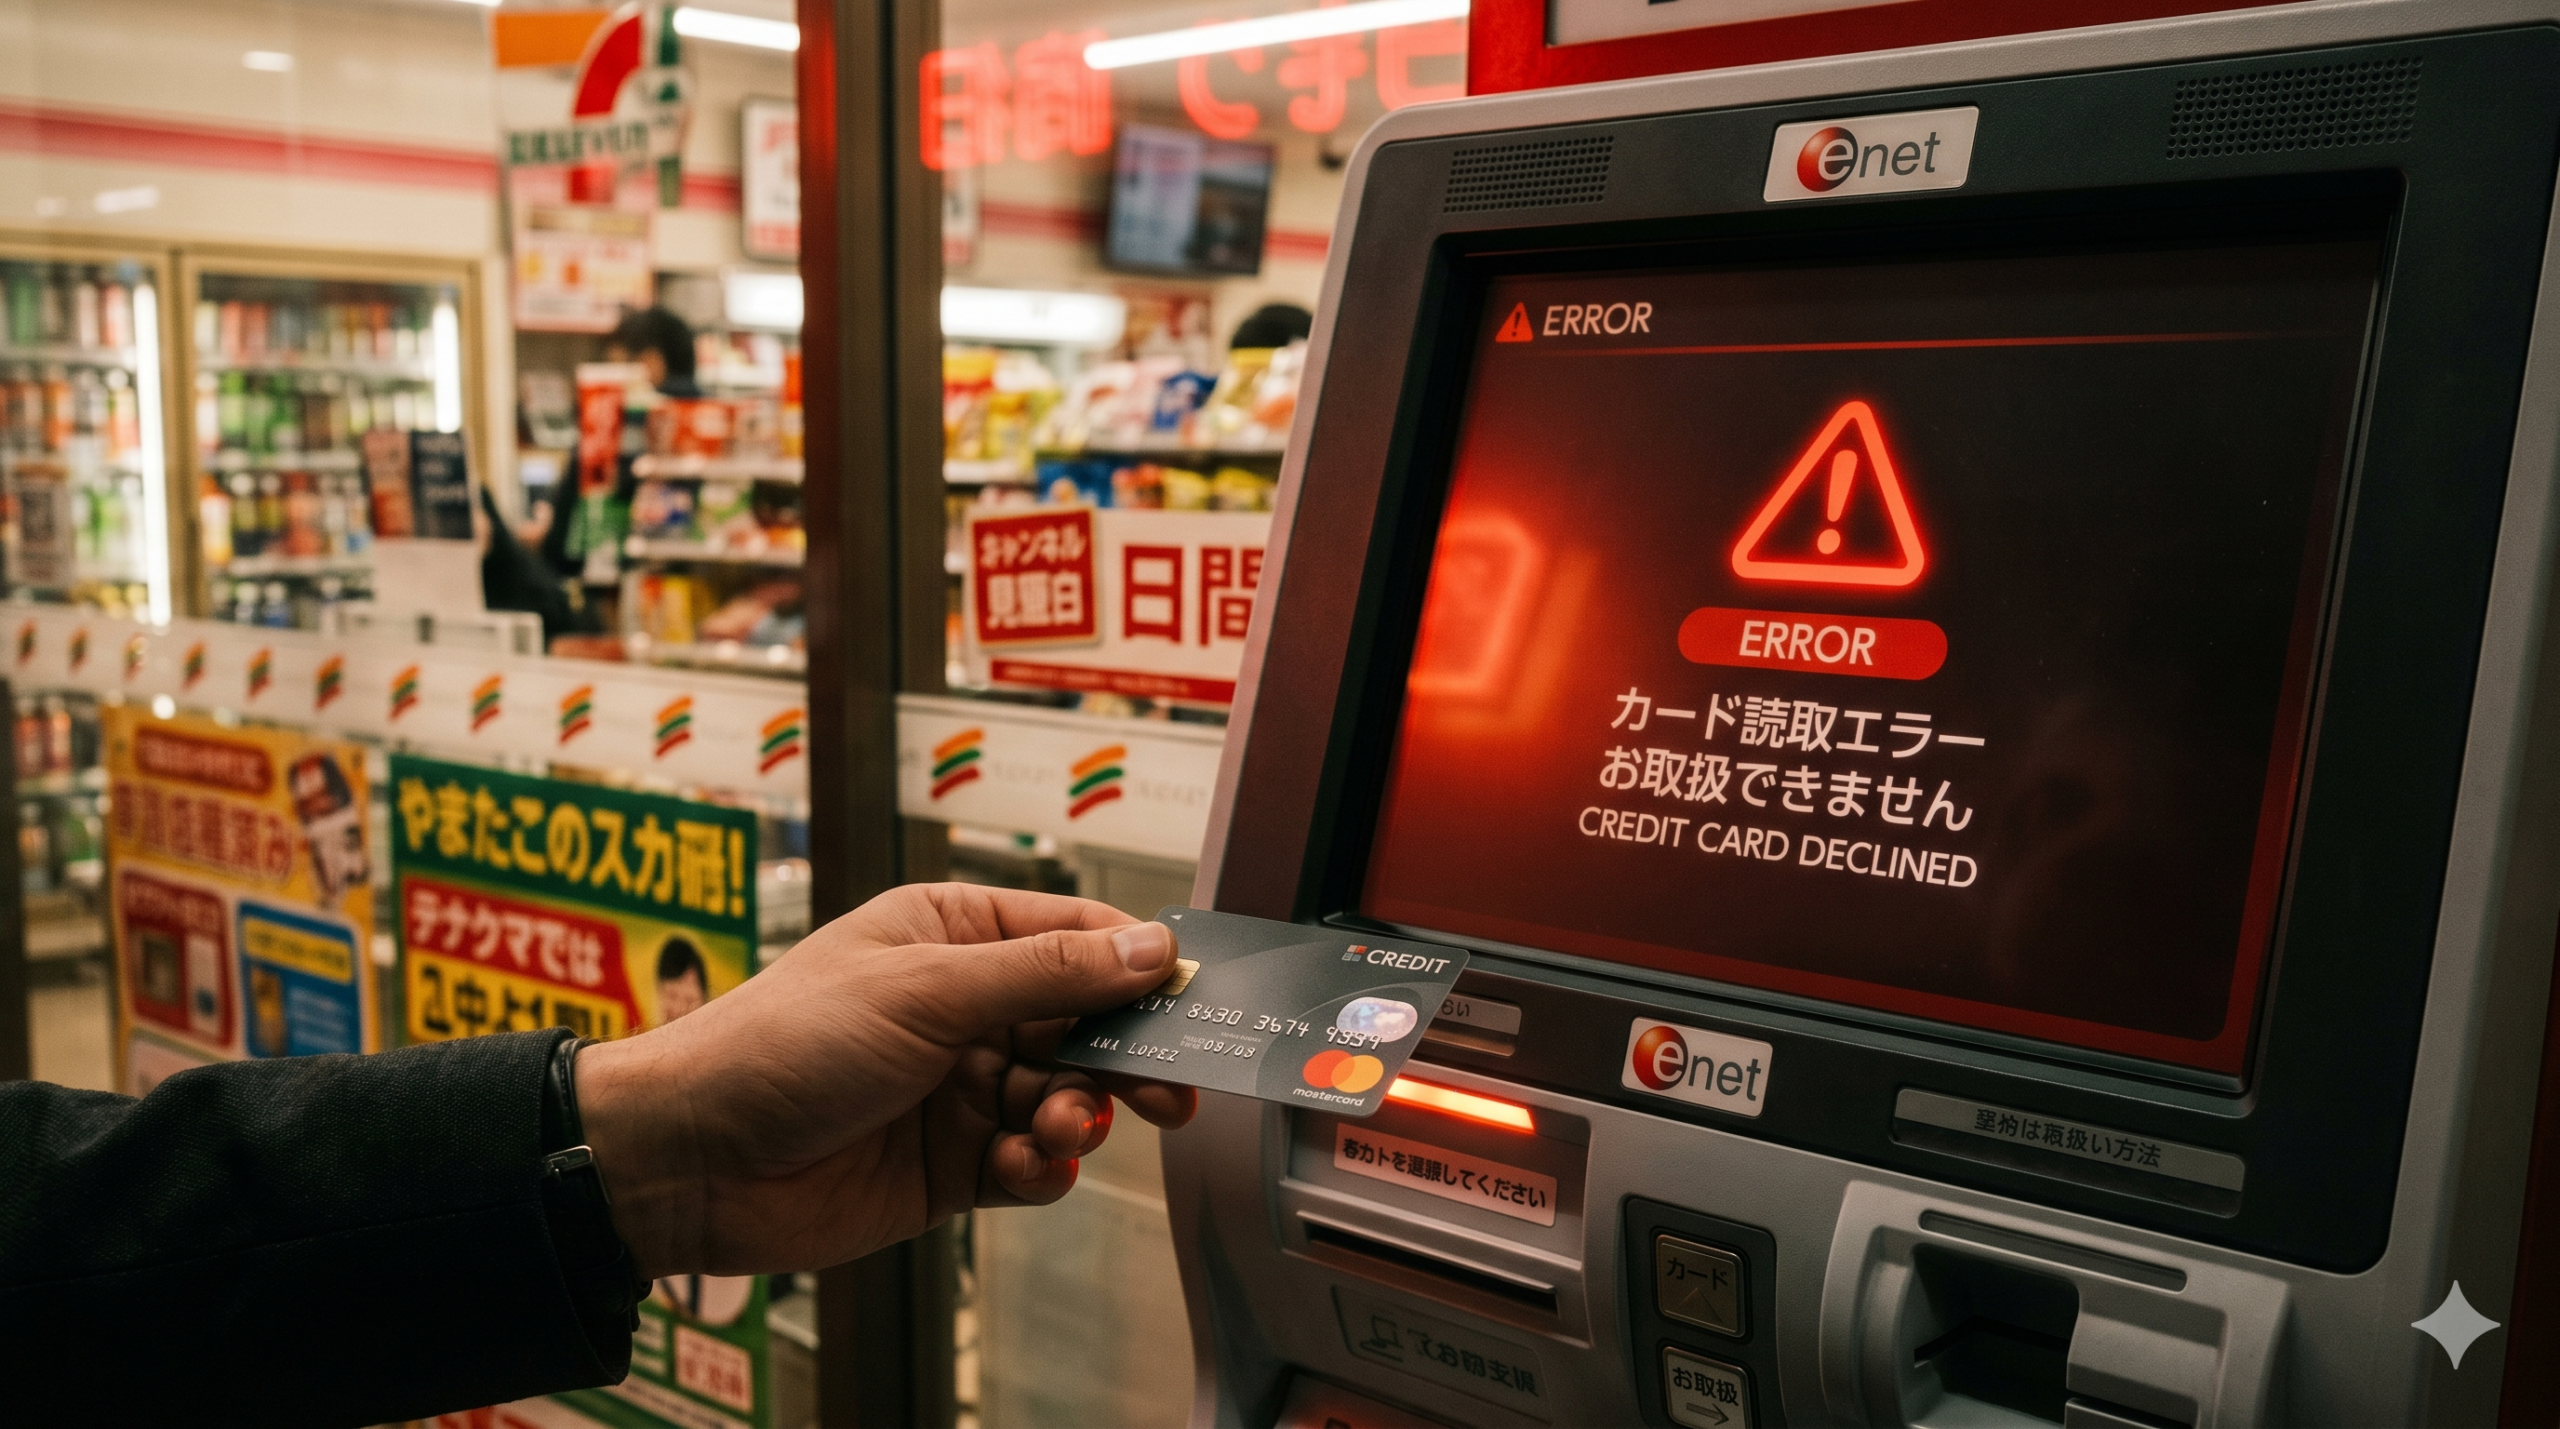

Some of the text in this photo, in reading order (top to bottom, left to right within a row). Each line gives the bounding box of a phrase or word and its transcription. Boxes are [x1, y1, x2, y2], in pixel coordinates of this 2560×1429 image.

[1818, 131, 1941, 182] enet
[1542, 302, 1653, 336] ERROR
[1739, 619, 1877, 667] ERROR
[1610, 686, 1986, 759] カード読取エラー
[1598, 745, 1974, 833] お取扱できません
[1578, 806, 1979, 889] CREDIT CARD DECLINED
[1366, 948, 1451, 975] CREDIT
[1126, 1041, 1181, 1063] LOPEZ
[1652, 1040, 1762, 1102] enet
[1666, 1257, 1729, 1291] カード
[1672, 1366, 1740, 1407] お取扱
